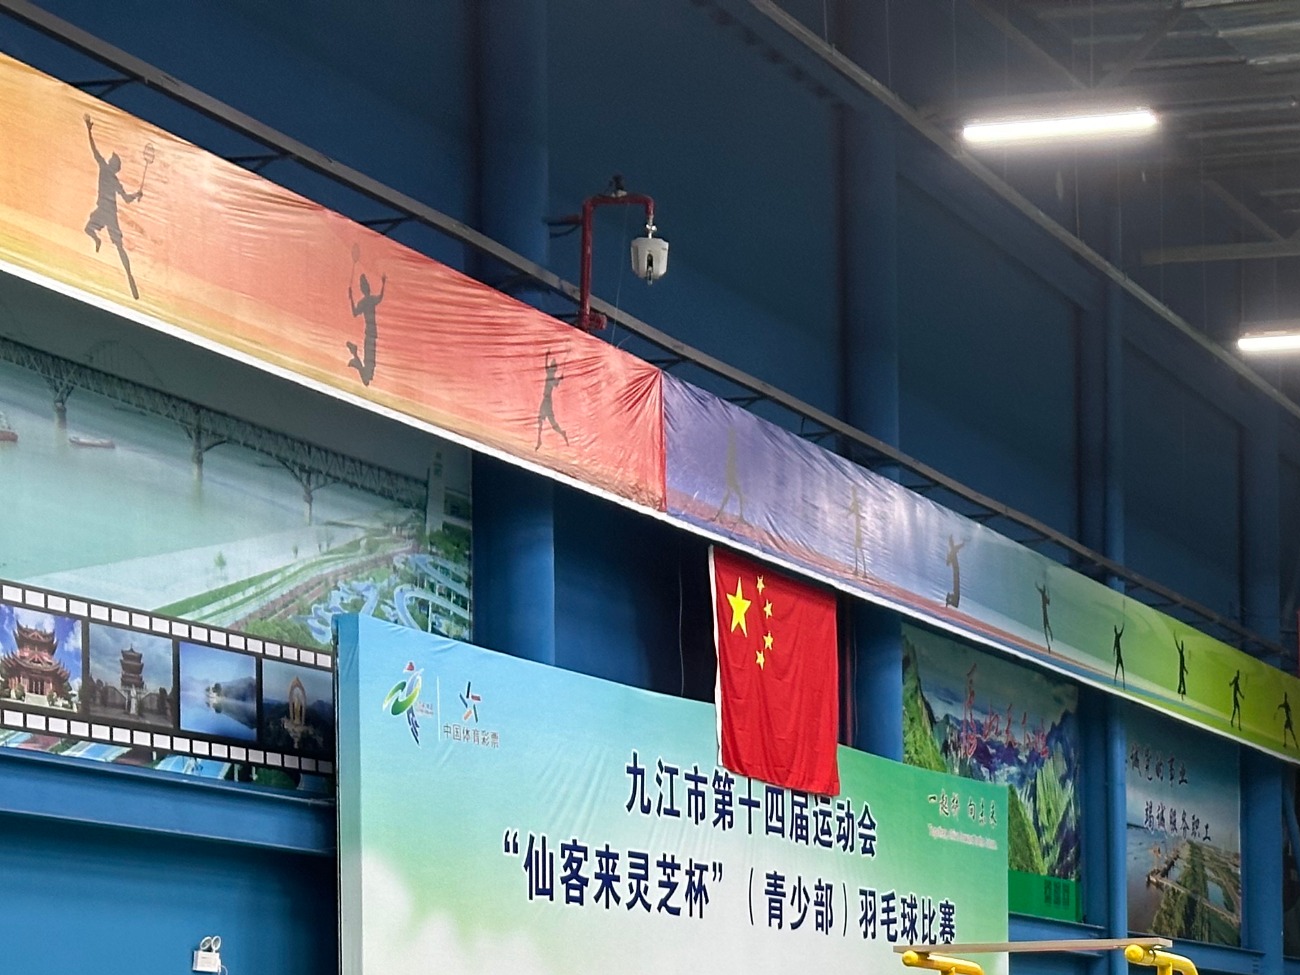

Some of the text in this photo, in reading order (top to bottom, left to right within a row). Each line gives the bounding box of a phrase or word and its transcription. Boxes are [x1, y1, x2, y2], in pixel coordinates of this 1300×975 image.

[443, 723, 499, 749] 中国体育彩票
[625, 750, 877, 858] 九江市第十四届运动会
